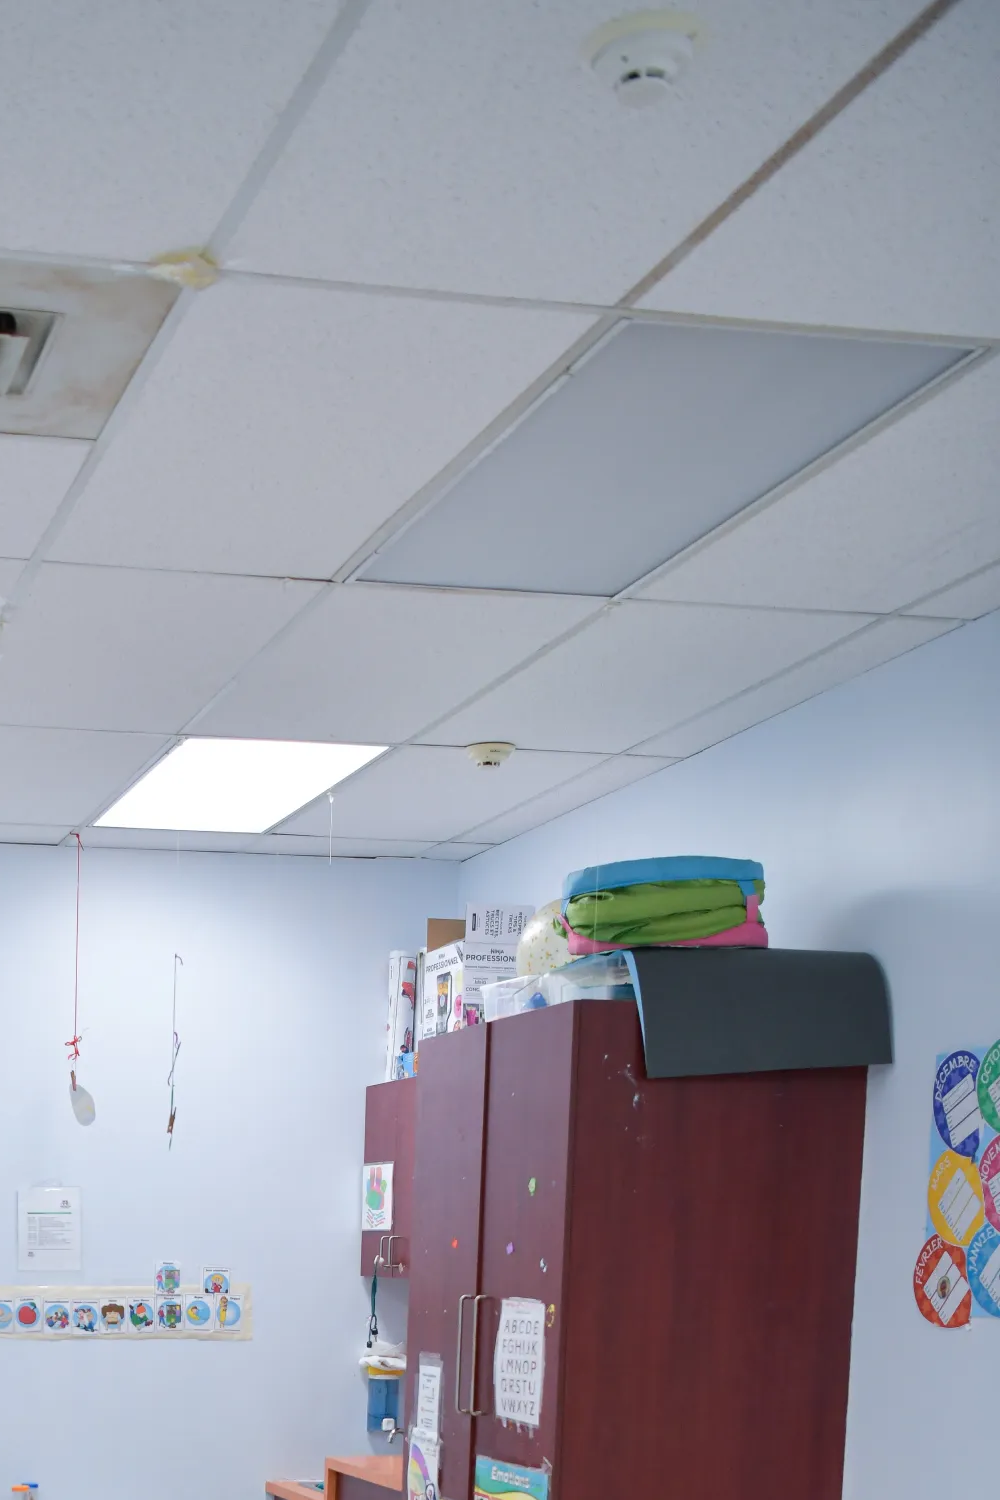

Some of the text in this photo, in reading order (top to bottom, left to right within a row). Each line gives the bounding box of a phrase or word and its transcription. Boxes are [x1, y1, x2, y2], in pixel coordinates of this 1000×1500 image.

[981, 1045, 1000, 1084] OCTO
[931, 1155, 952, 1191] MARS
[968, 1226, 997, 1275] JANVIE
[491, 1465, 530, 1489] Emotions
